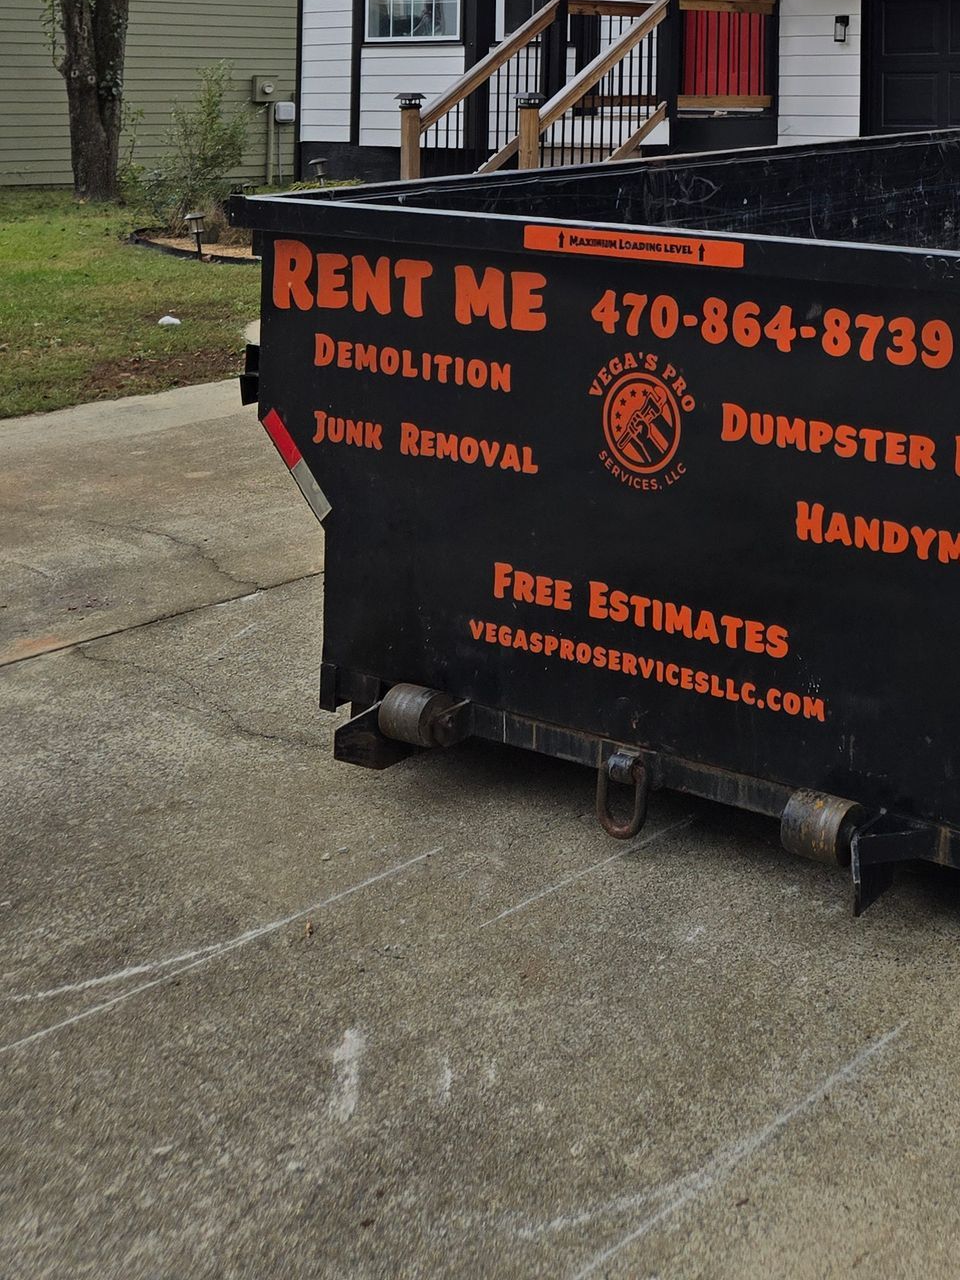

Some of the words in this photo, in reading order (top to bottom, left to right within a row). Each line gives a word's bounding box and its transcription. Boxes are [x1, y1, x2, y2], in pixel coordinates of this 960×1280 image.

[569, 235, 617, 250] MAXIMUM
[619, 238, 662, 252] LOADING
[664, 243, 692, 254] LEVEL
[273, 240, 433, 318] RENT
[455, 265, 547, 331] ME
[590, 289, 954, 369] 470-864-8739
[314, 333, 511, 392] DEMOLITION
[588, 351, 658, 396] VEGA'S
[661, 363, 696, 412] PRO
[313, 411, 382, 449] JUNK
[400, 422, 538, 474] REMOVAL
[721, 403, 936, 470] DUMPSTER
[598, 450, 663, 490] SERVICES,
[664, 462, 687, 485] LLC
[494, 562, 572, 610] FREE
[588, 580, 789, 659] ESTIMATES
[468, 619, 826, 722] VEGASPROSERVICESLLC.COM
